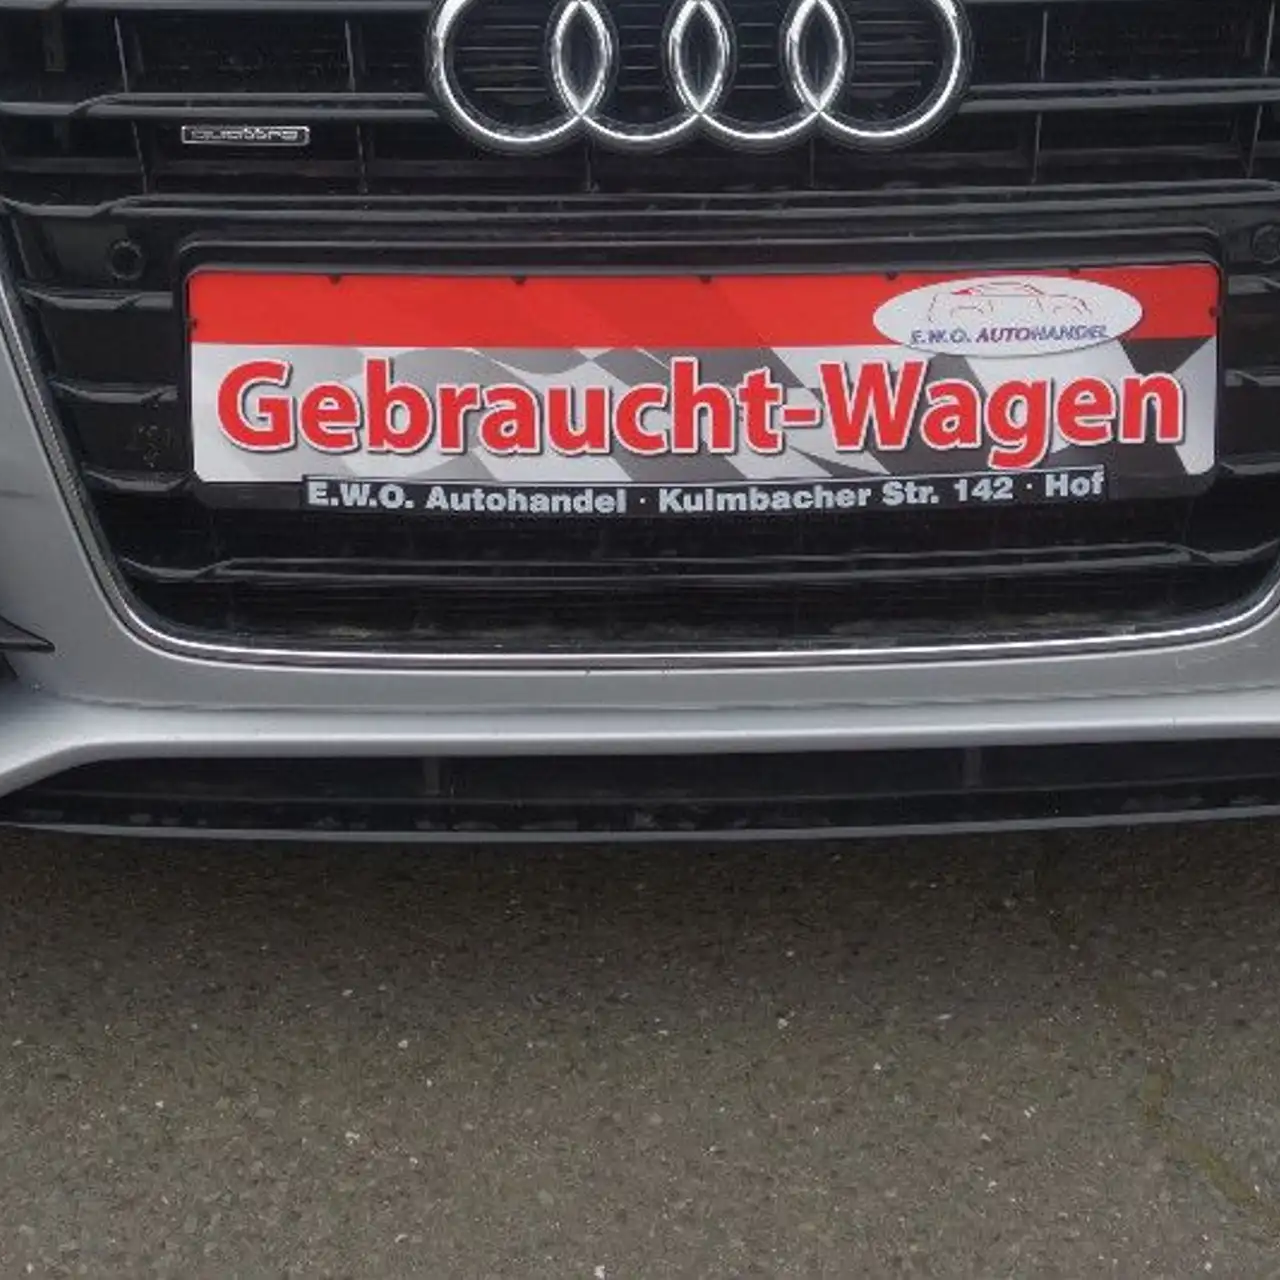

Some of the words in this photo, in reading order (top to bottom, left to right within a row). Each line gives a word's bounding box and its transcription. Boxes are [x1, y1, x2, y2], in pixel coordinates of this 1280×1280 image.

[975, 323, 1109, 344] AUTOHANDEL
[216, 357, 1184, 468] Gebraucht-Wagen
[306, 480, 415, 510] E.W.O.
[425, 484, 628, 514] Autohandel
[658, 480, 872, 513] Kulmbacher
[881, 479, 940, 506] Str.
[953, 476, 1014, 502] 142
[1044, 470, 1105, 497] Hof
